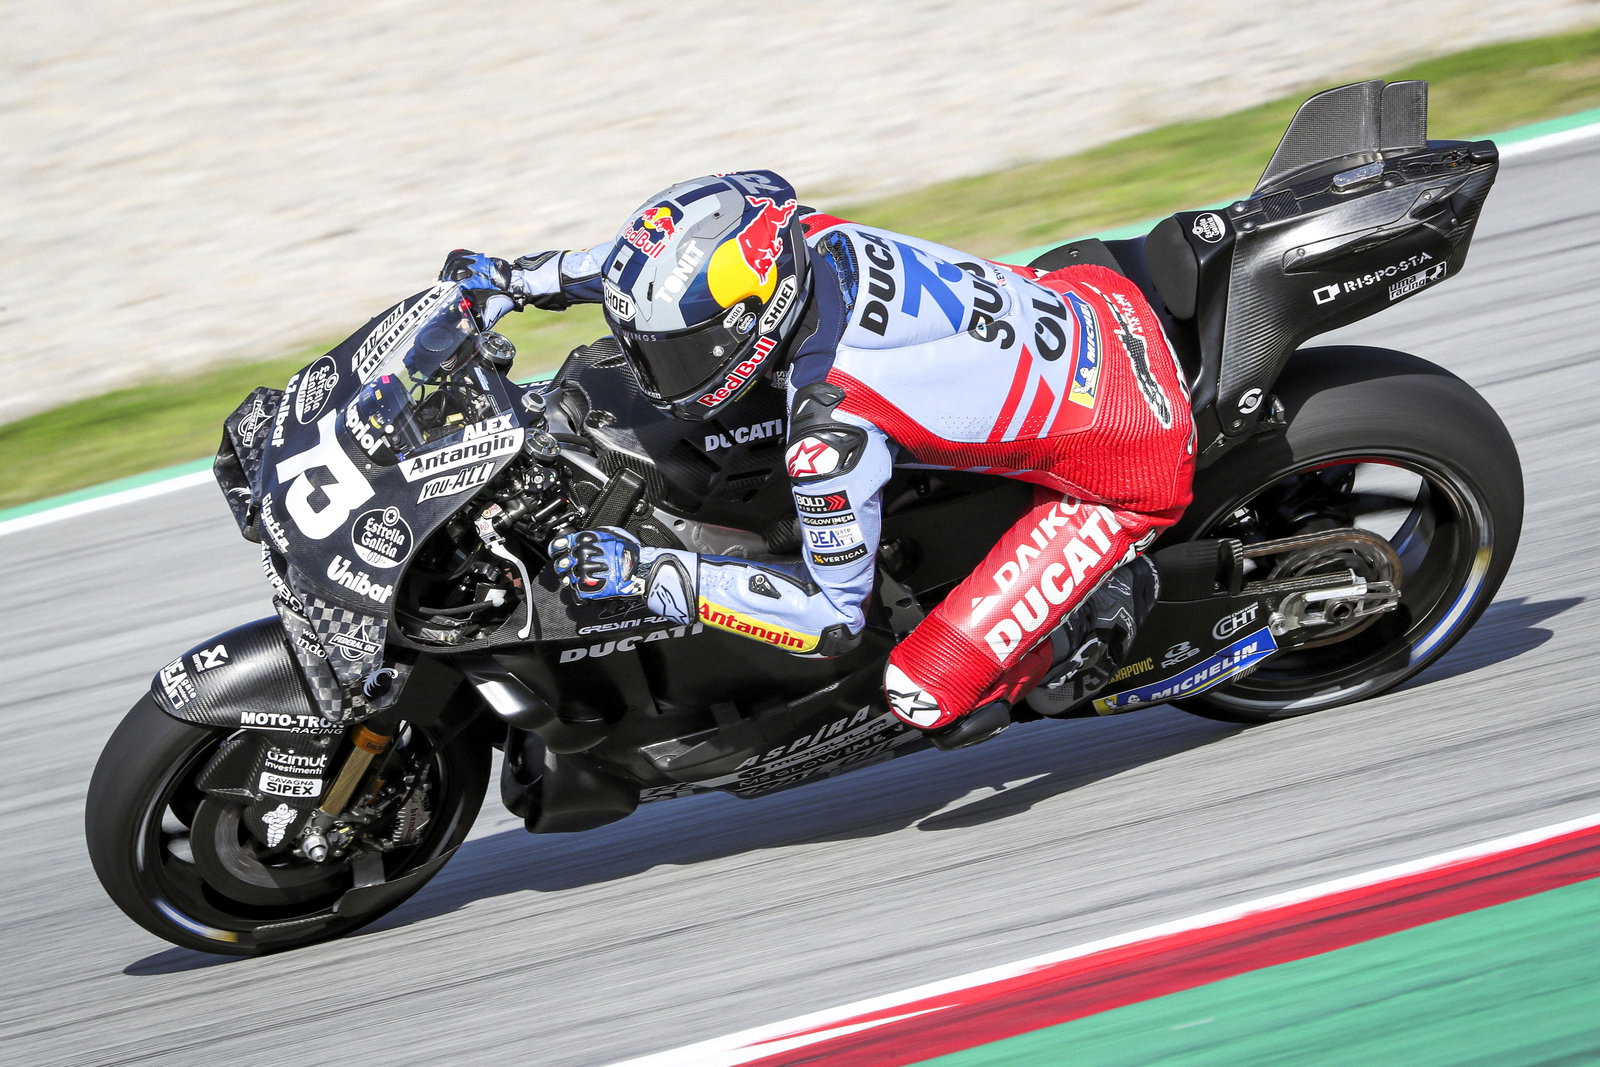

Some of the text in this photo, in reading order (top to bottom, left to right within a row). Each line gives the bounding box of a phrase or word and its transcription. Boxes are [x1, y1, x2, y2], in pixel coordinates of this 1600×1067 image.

[635, 231, 666, 259] Bull
[654, 239, 706, 303] TONIT
[727, 306, 743, 324] SHOEI
[764, 284, 794, 328] SHOEI
[355, 305, 404, 366] YOU-ALL
[362, 286, 444, 374] Antangin
[623, 331, 657, 341] WINGS
[1077, 301, 1096, 364] MICHEL
[698, 376, 741, 407] Red
[741, 335, 777, 378] Bull
[303, 370, 320, 414] Galicia
[312, 365, 330, 411] Estrella
[463, 414, 514, 441] ALEX
[705, 418, 783, 452] DUCATI
[410, 436, 515, 475] Antangin
[423, 463, 488, 499] YOU-ALL
[796, 493, 825, 507] BOLD
[361, 531, 397, 558] Galicia
[363, 517, 405, 546] Estrella
[810, 530, 840, 547] DEA
[823, 549, 865, 563] VERTICAL
[327, 555, 393, 603] Unibat
[984, 505, 1122, 663] DUCATI
[578, 619, 641, 635] GRESINI
[698, 603, 804, 649] Antangin
[334, 635, 376, 653] FEDERAL OIL
[559, 623, 704, 663] DUCATI
[1108, 657, 1154, 684] RAPOVIČ
[1151, 641, 1258, 700] MICHELIN
[241, 711, 344, 729] MOTO-TRO
[265, 759, 323, 774] investimenti
[267, 748, 327, 767] azimut
[775, 750, 842, 777] GLOW
[266, 782, 314, 795] SIPEX
[267, 775, 314, 786] CAVAGNA
